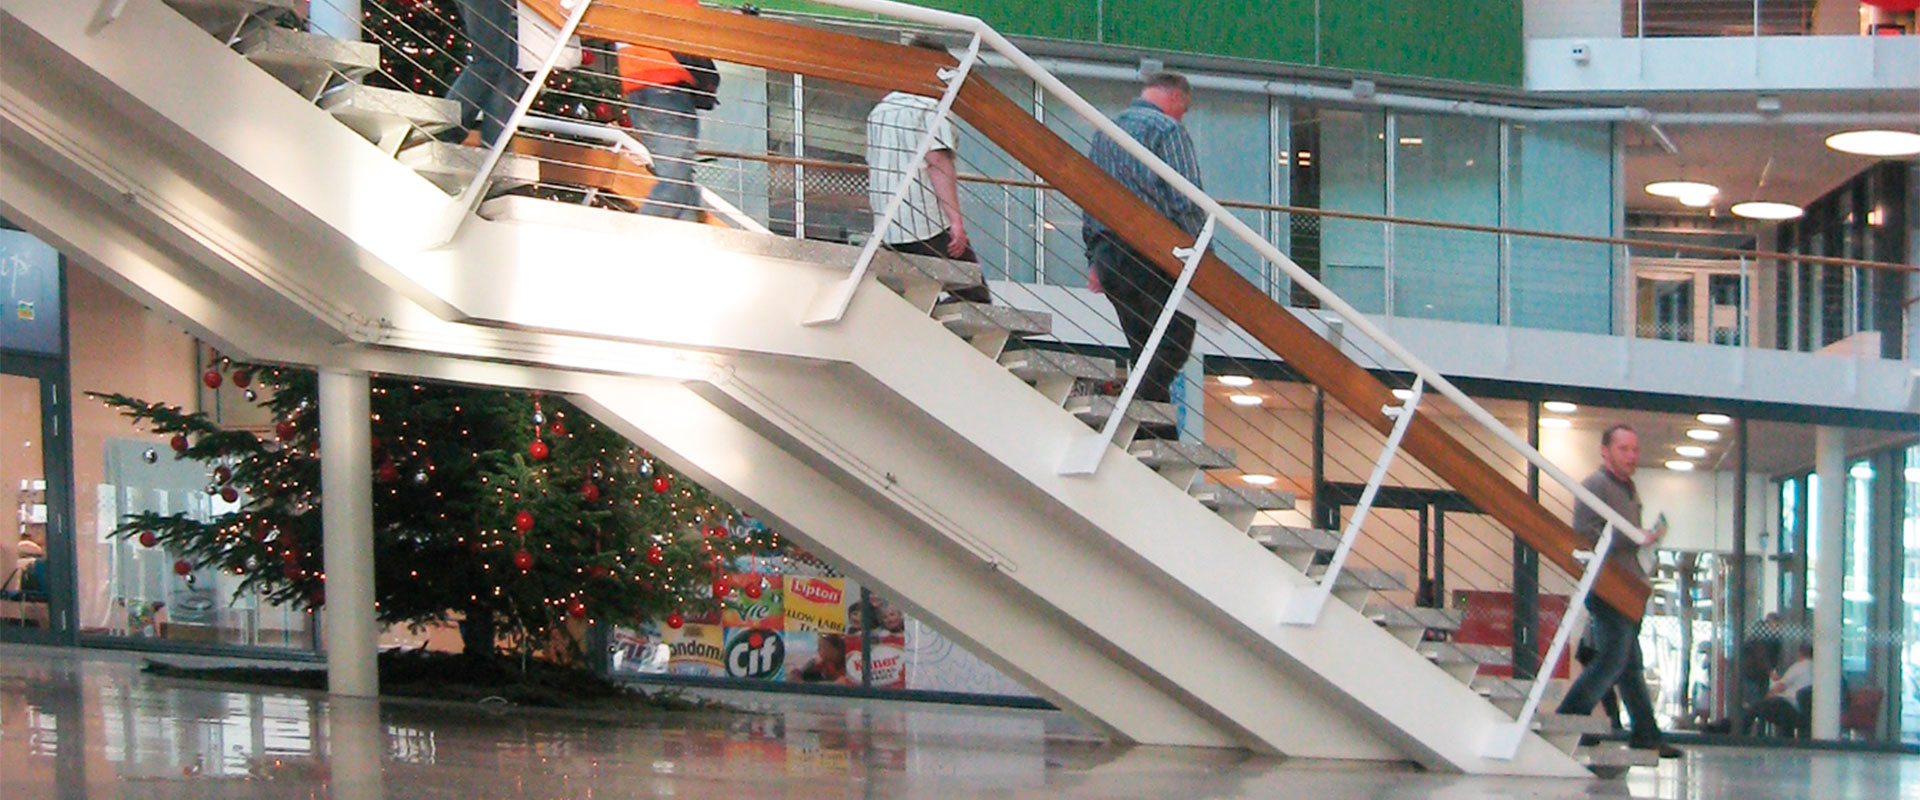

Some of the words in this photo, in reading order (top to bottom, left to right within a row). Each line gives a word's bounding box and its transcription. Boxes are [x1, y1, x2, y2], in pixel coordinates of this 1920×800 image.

[795, 579, 838, 601] Lipton
[784, 608, 816, 623] LLOW
[728, 633, 777, 678] Cif
